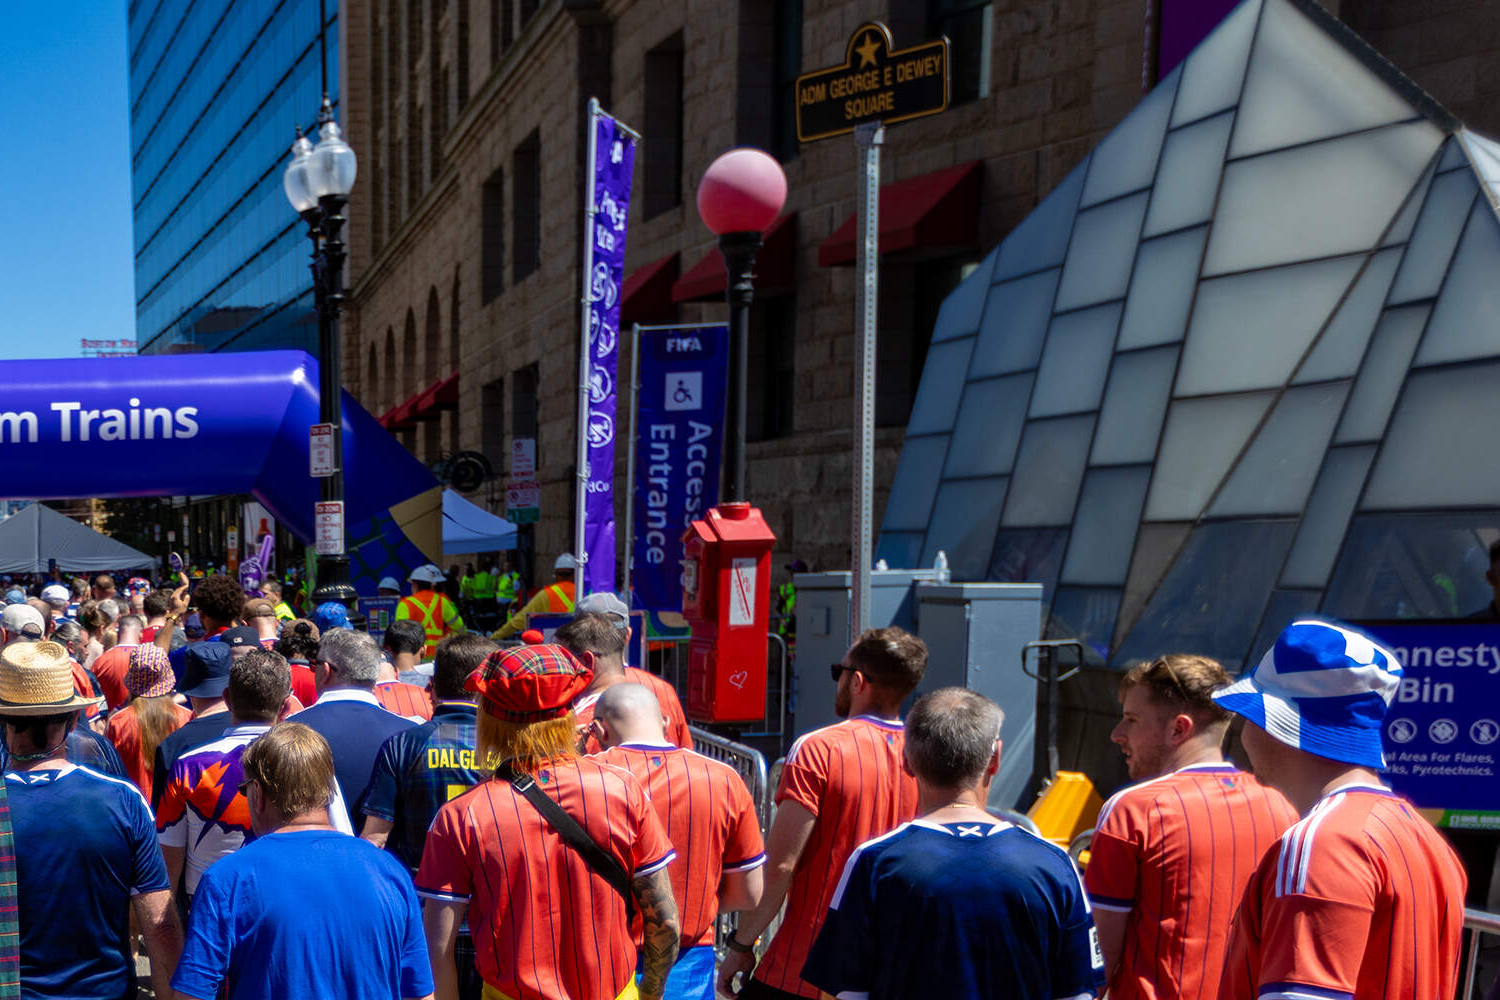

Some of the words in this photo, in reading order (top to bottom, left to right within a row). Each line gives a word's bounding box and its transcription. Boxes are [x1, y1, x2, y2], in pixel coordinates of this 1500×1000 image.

[801, 83, 827, 105] ADM
[829, 69, 881, 99] GEORGE
[884, 67, 893, 86] E
[896, 55, 942, 82] DEWEY
[845, 91, 896, 120] SQUARE
[666, 338, 703, 353] FIFA
[50, 397, 200, 442] Trains
[646, 423, 676, 565] Entrance
[1394, 643, 1500, 675] nesty
[1397, 677, 1455, 703] Bin
[1398, 752, 1428, 763] Area
[1431, 752, 1451, 762] For
[1454, 753, 1495, 764] Flares,
[1411, 764, 1494, 777] Pyrotechnics.
